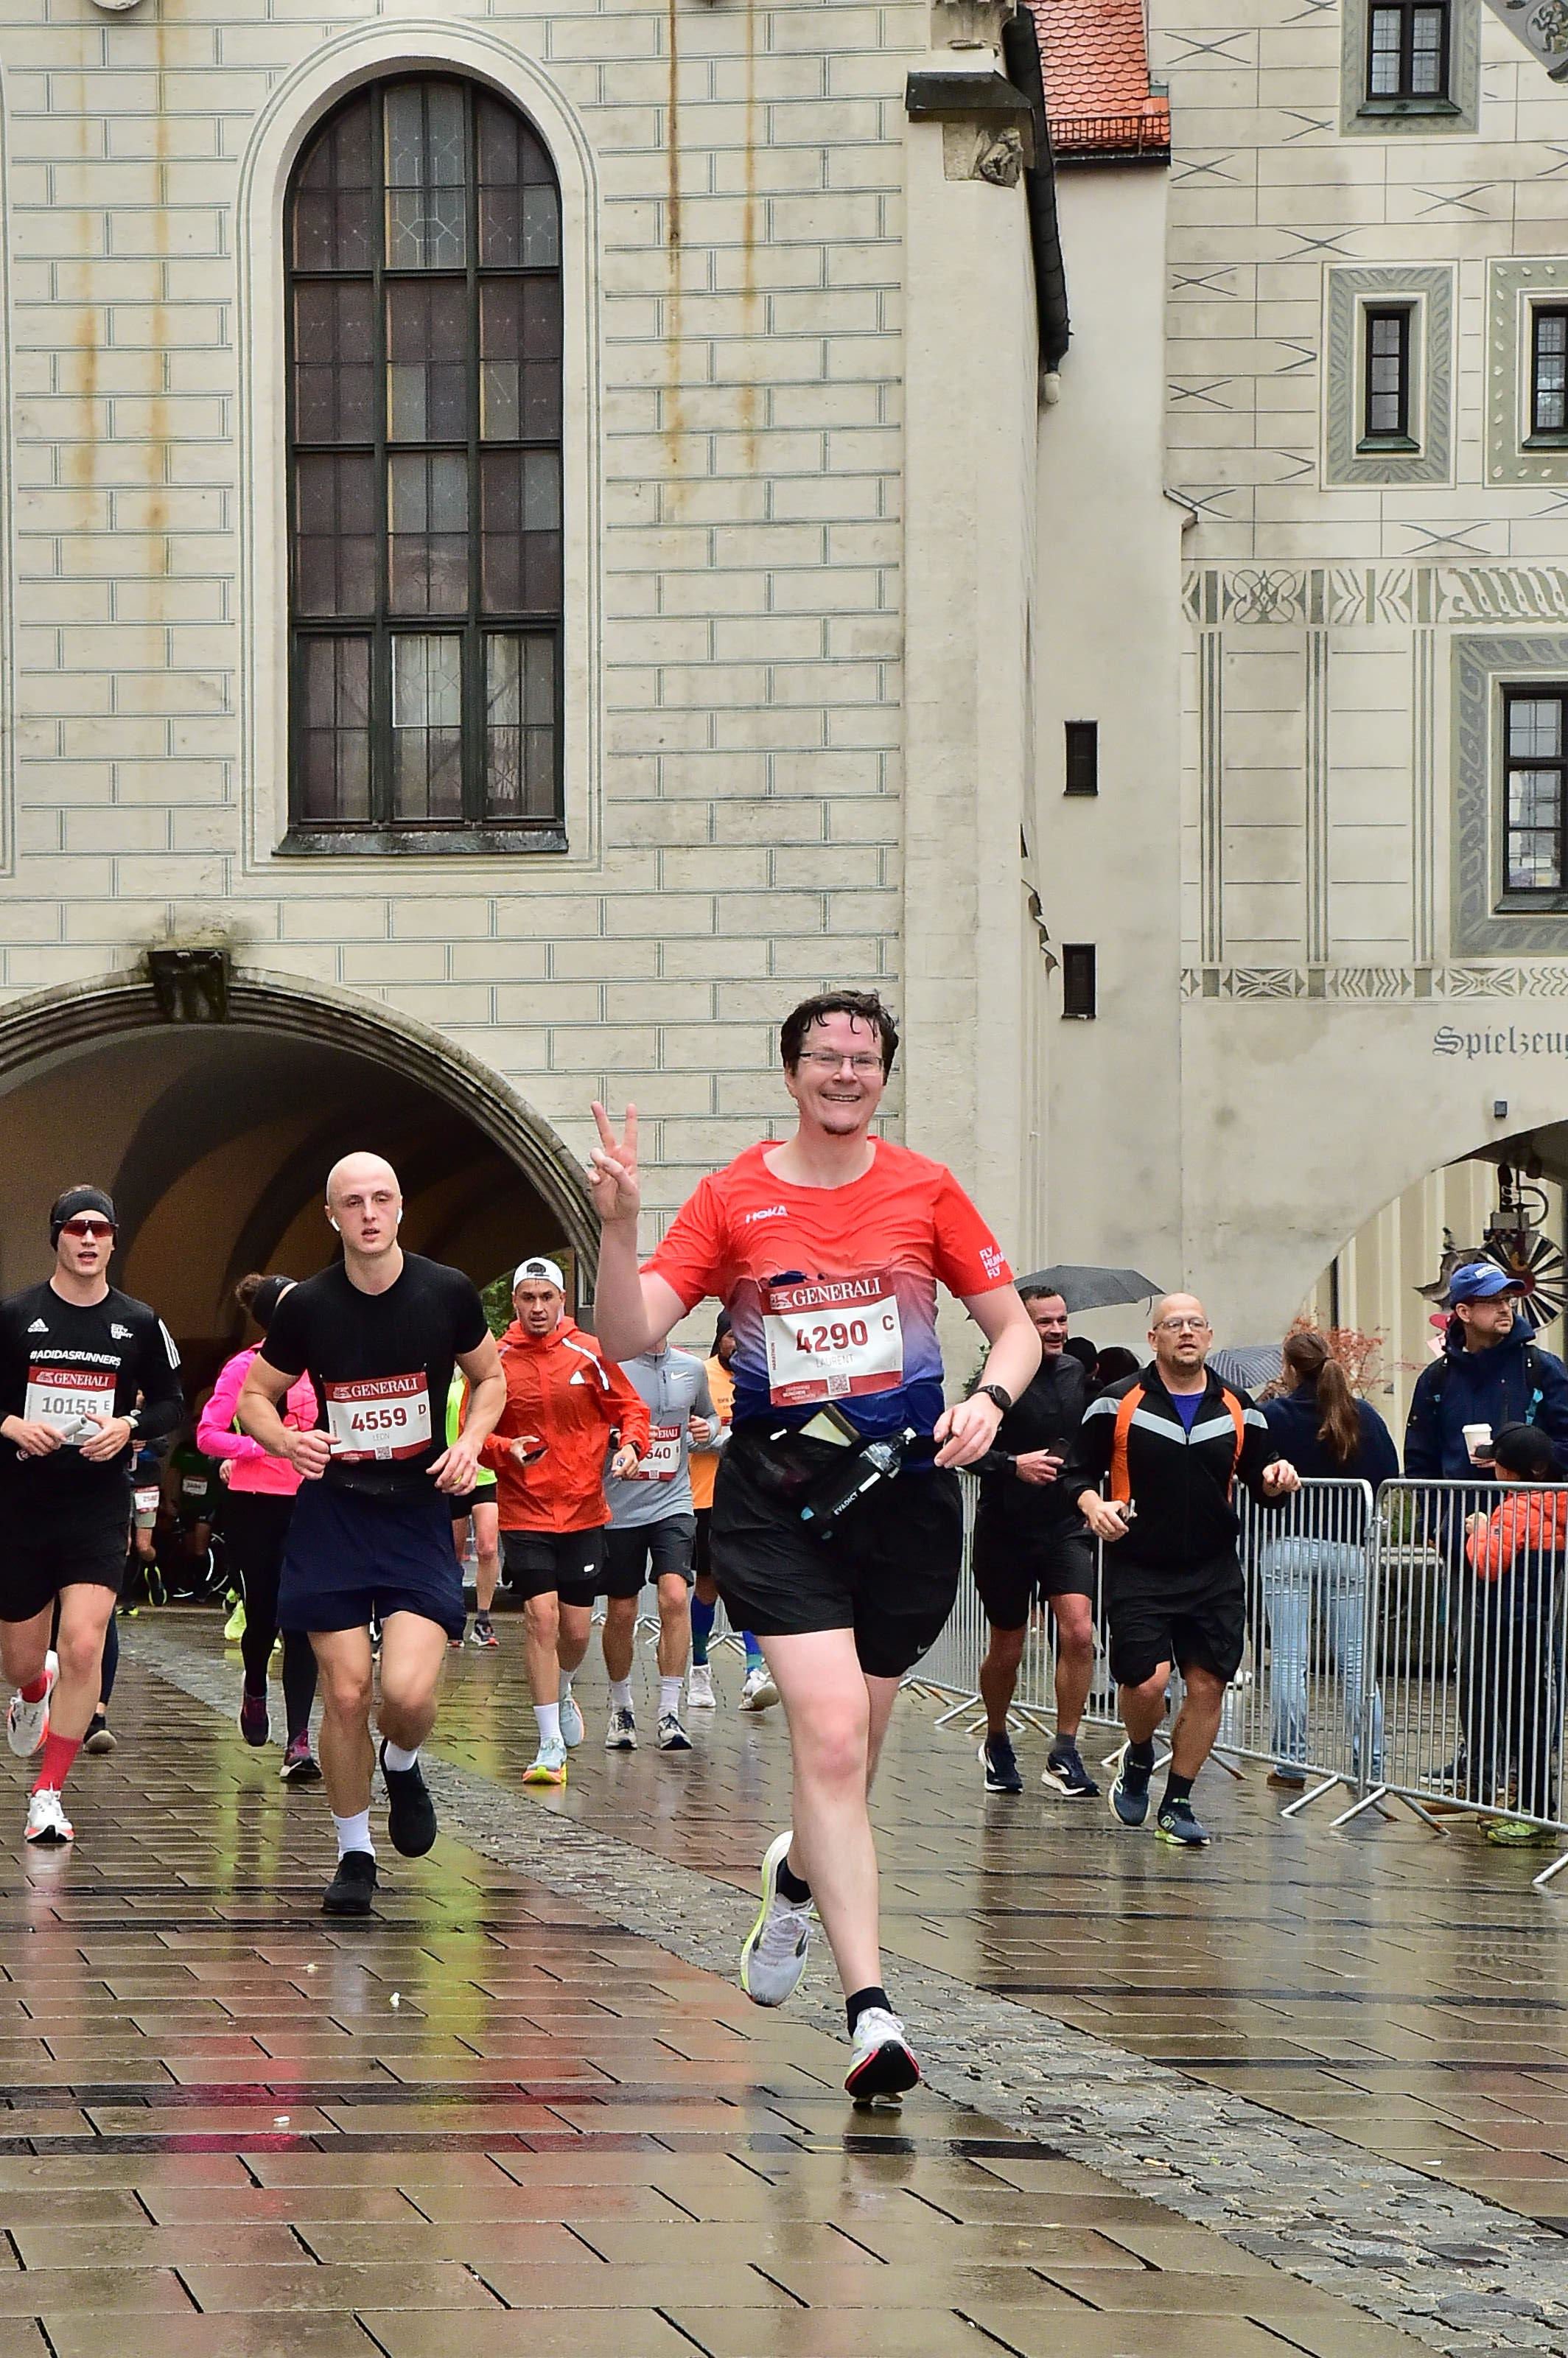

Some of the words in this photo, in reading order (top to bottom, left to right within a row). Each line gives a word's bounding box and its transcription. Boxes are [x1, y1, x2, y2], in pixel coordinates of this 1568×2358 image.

[1432, 1025, 1568, 1060] Spielzeu
[745, 1205, 788, 1224] HOKA
[979, 1245, 993, 1261] FLY
[987, 1265, 1001, 1280] FLY
[792, 1277, 883, 1306] GENERALI
[882, 1315, 895, 1331] C
[796, 1320, 868, 1354] 4290
[29, 1349, 122, 1367] #ADIDASRUNNERS
[815, 1354, 854, 1368] LAURENT
[55, 1372, 110, 1388] GENERALI
[351, 1377, 419, 1398] GENERALI
[41, 1396, 97, 1415] 10155
[104, 1401, 111, 1410] E
[418, 1404, 427, 1415] D
[351, 1407, 407, 1432] 4559
